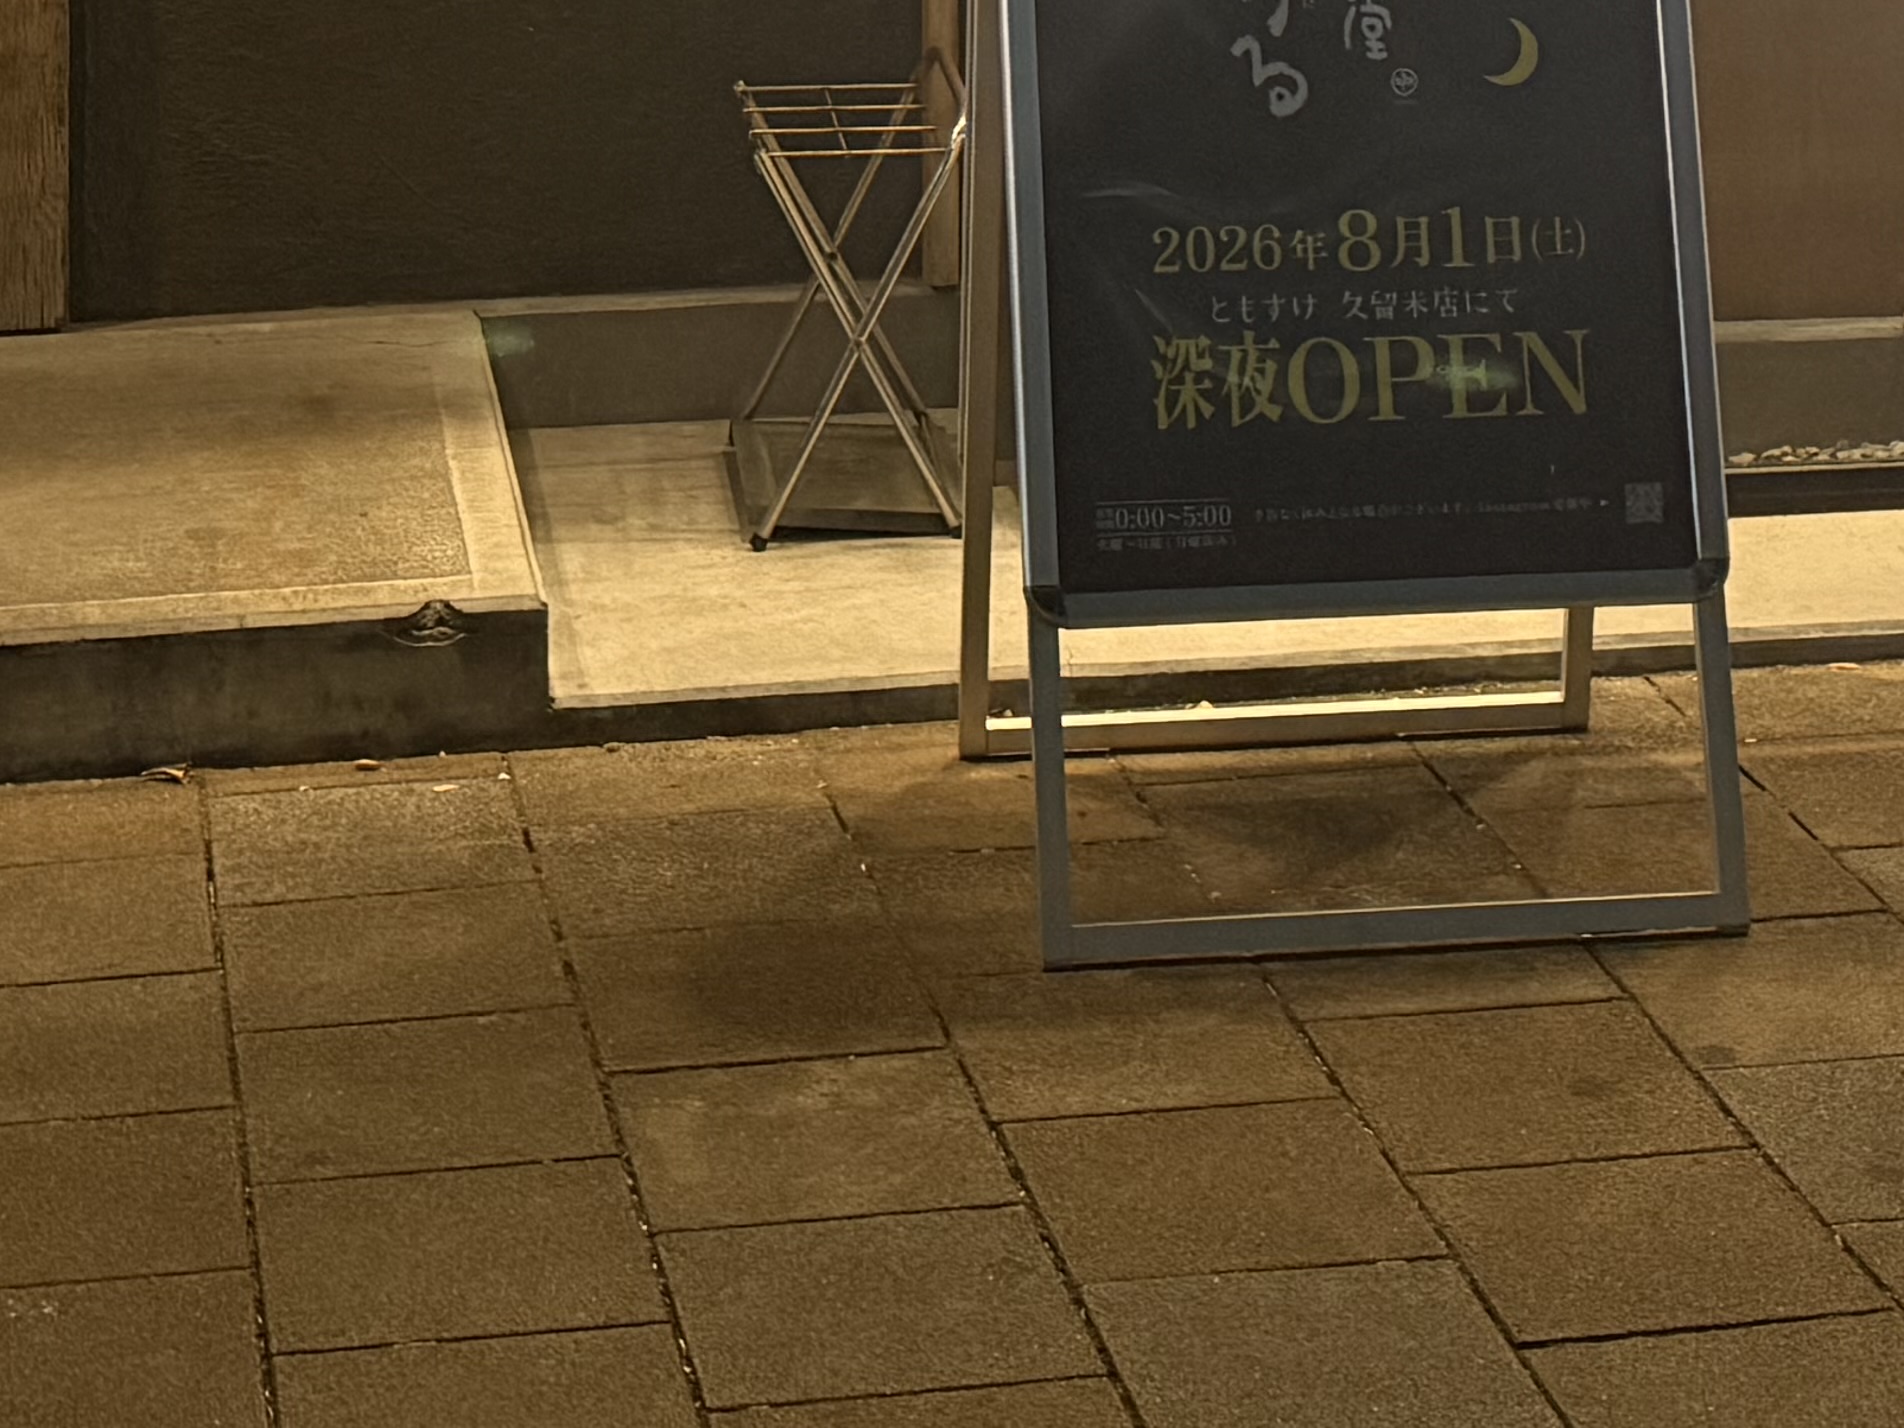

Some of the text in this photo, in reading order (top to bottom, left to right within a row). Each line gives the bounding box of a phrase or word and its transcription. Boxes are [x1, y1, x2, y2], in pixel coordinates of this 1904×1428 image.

[1152, 205, 1588, 276] 2026年8月1日(土)
[1209, 286, 1520, 324] ともすけ 久留米店にて
[1149, 327, 1592, 432] 深夜OPEN
